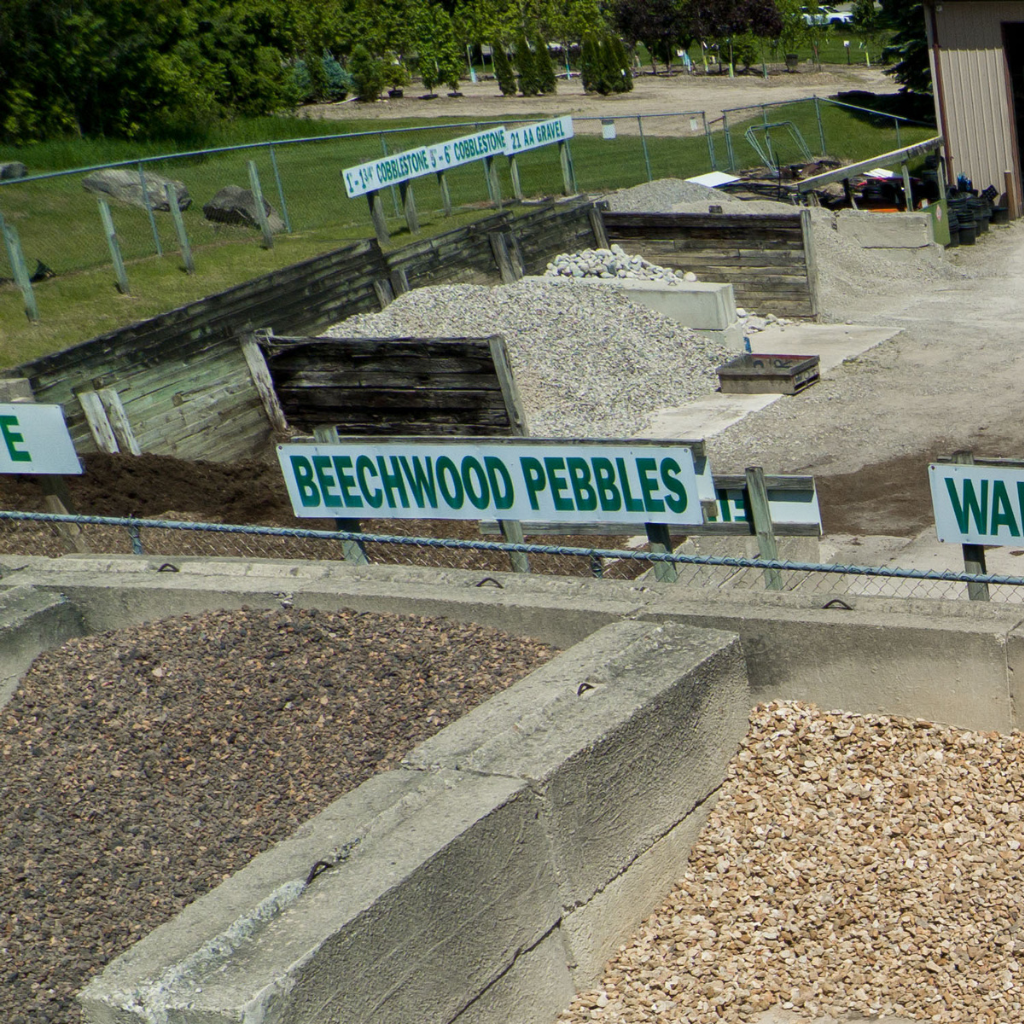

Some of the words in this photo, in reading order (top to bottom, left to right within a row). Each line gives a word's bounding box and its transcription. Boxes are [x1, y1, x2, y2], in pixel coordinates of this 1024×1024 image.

[454, 129, 507, 161] COBBLESTONE
[510, 132, 521, 149] 21
[523, 128, 535, 146] AA
[535, 120, 565, 142] GRAVEL
[376, 149, 429, 183] COBBLESTONE
[289, 454, 514, 510] BEECHWOOD
[519, 456, 688, 514] PEBBLES
